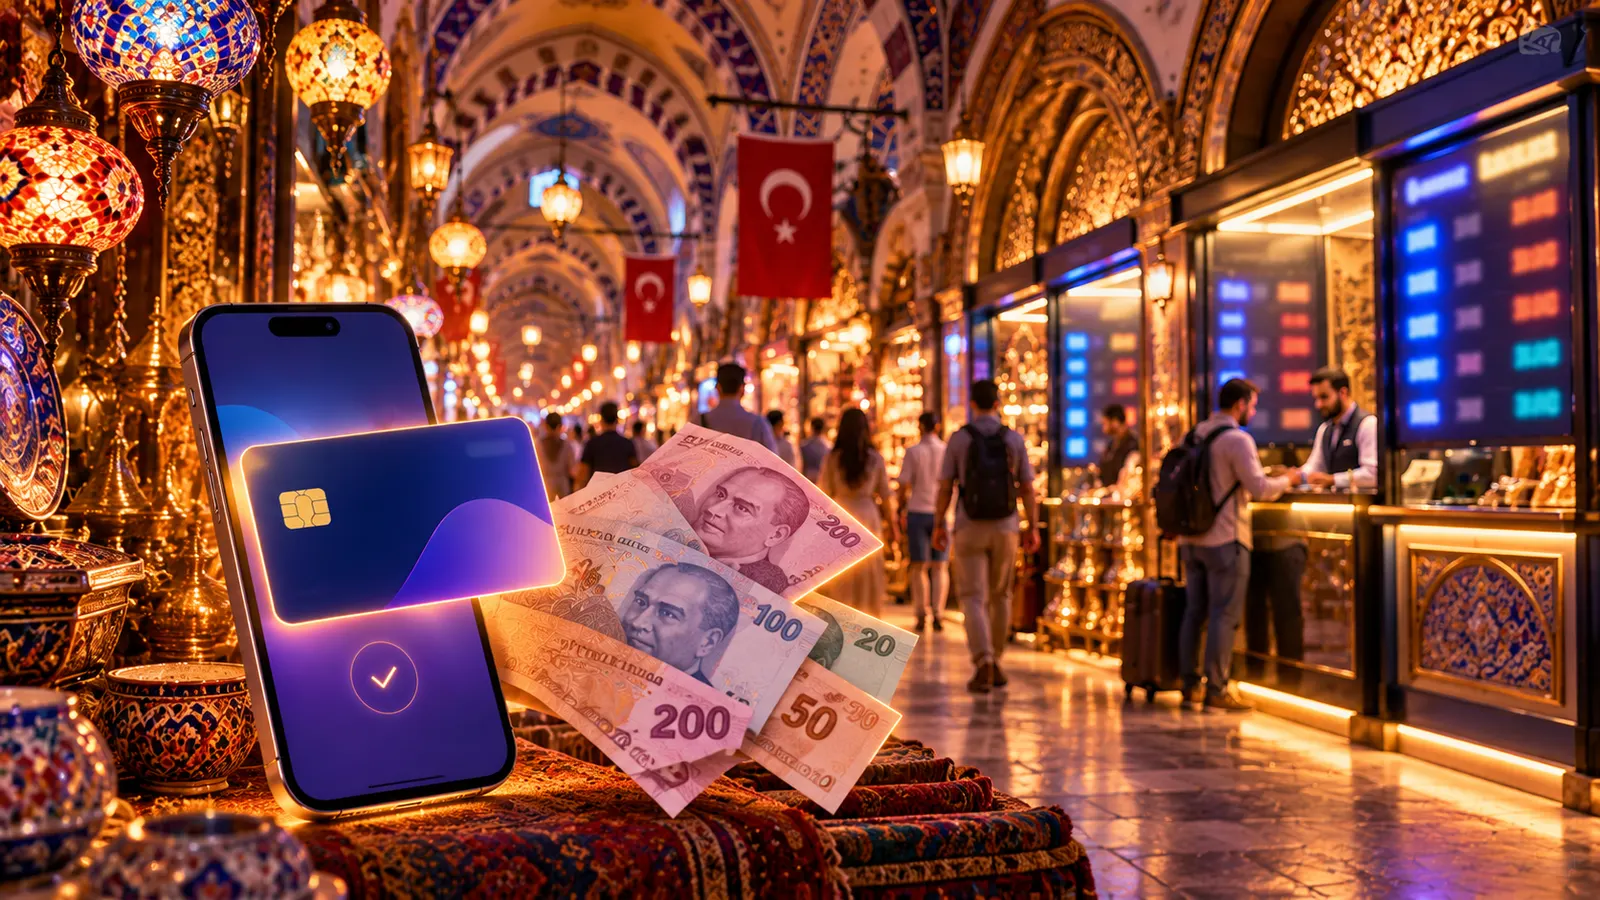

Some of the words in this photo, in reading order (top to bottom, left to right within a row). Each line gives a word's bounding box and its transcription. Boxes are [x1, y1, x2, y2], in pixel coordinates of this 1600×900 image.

[816, 514, 862, 548] 200
[753, 603, 803, 642] 100
[853, 627, 896, 657] 20
[650, 703, 731, 740] 200
[781, 693, 838, 741] 50
